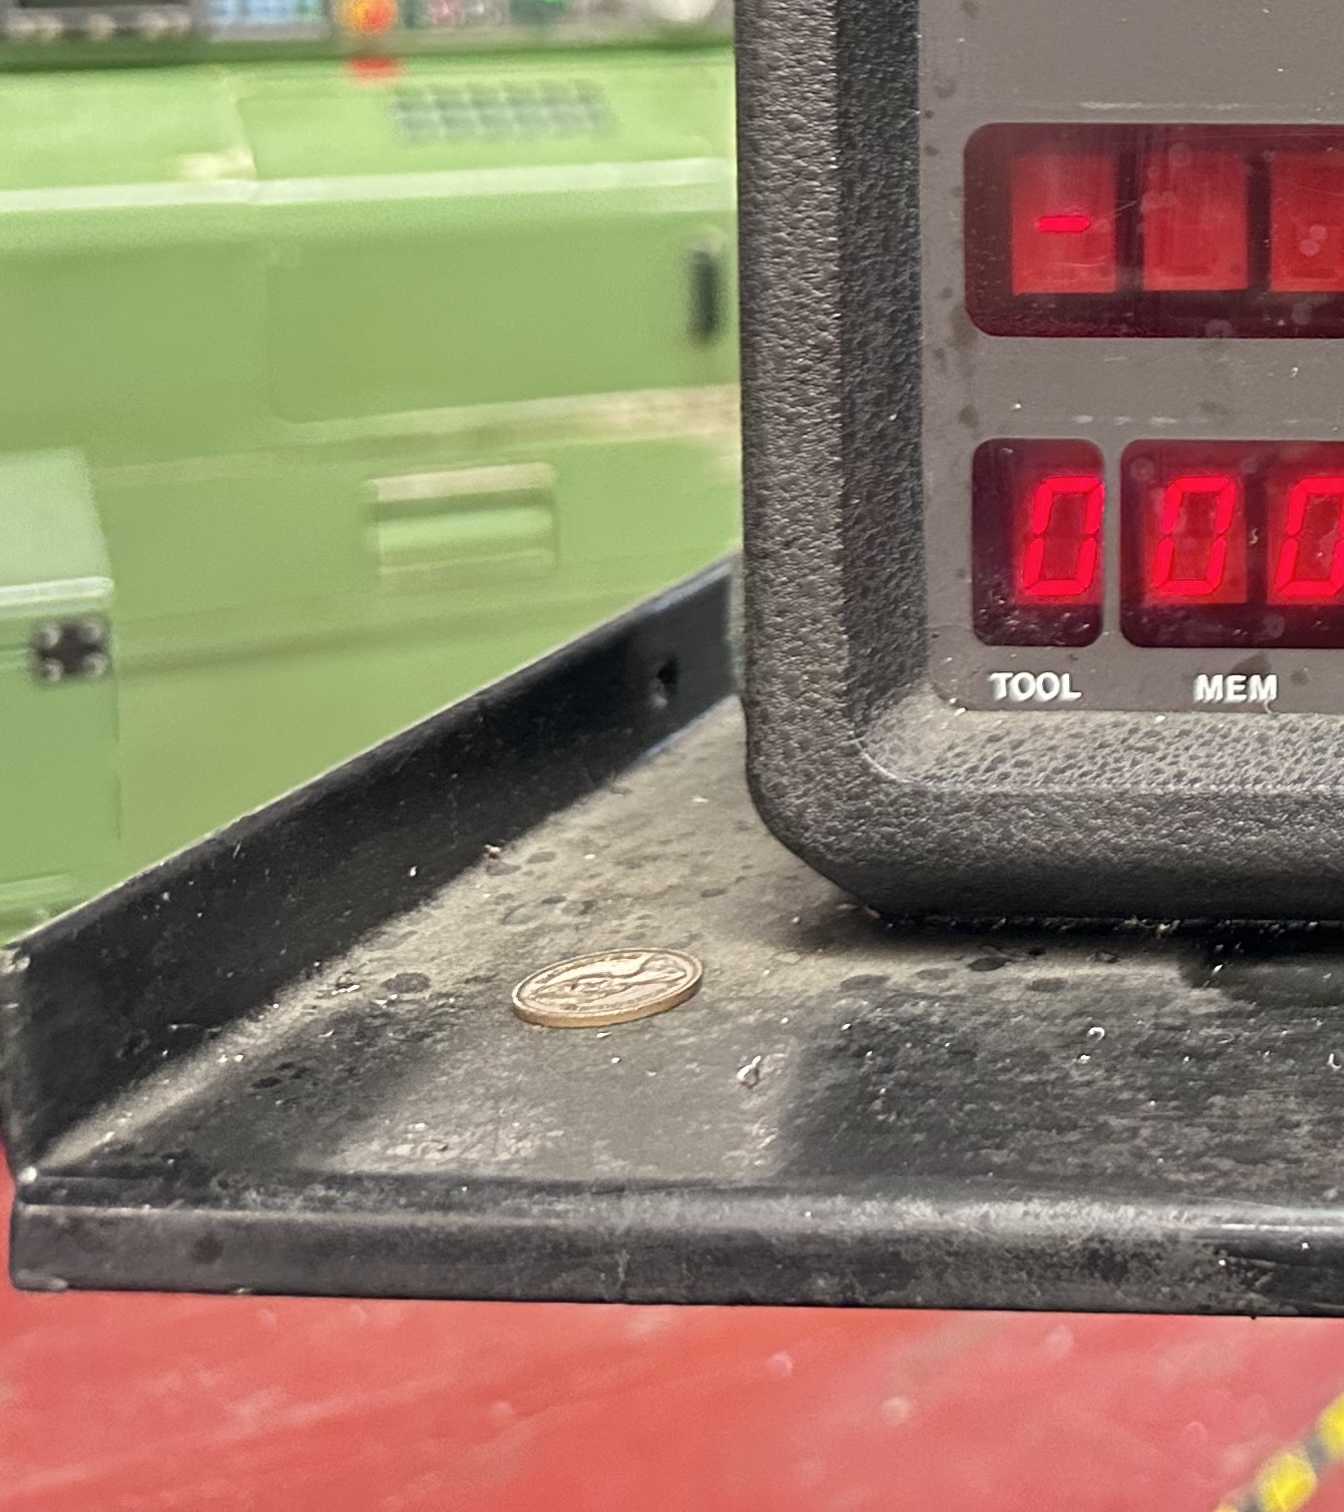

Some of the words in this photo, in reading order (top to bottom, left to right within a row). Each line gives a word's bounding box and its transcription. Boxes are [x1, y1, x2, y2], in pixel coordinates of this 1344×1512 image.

[1022, 476, 1105, 596] 0
[987, 671, 1082, 702] TOOL
[1193, 674, 1278, 707] MEM
